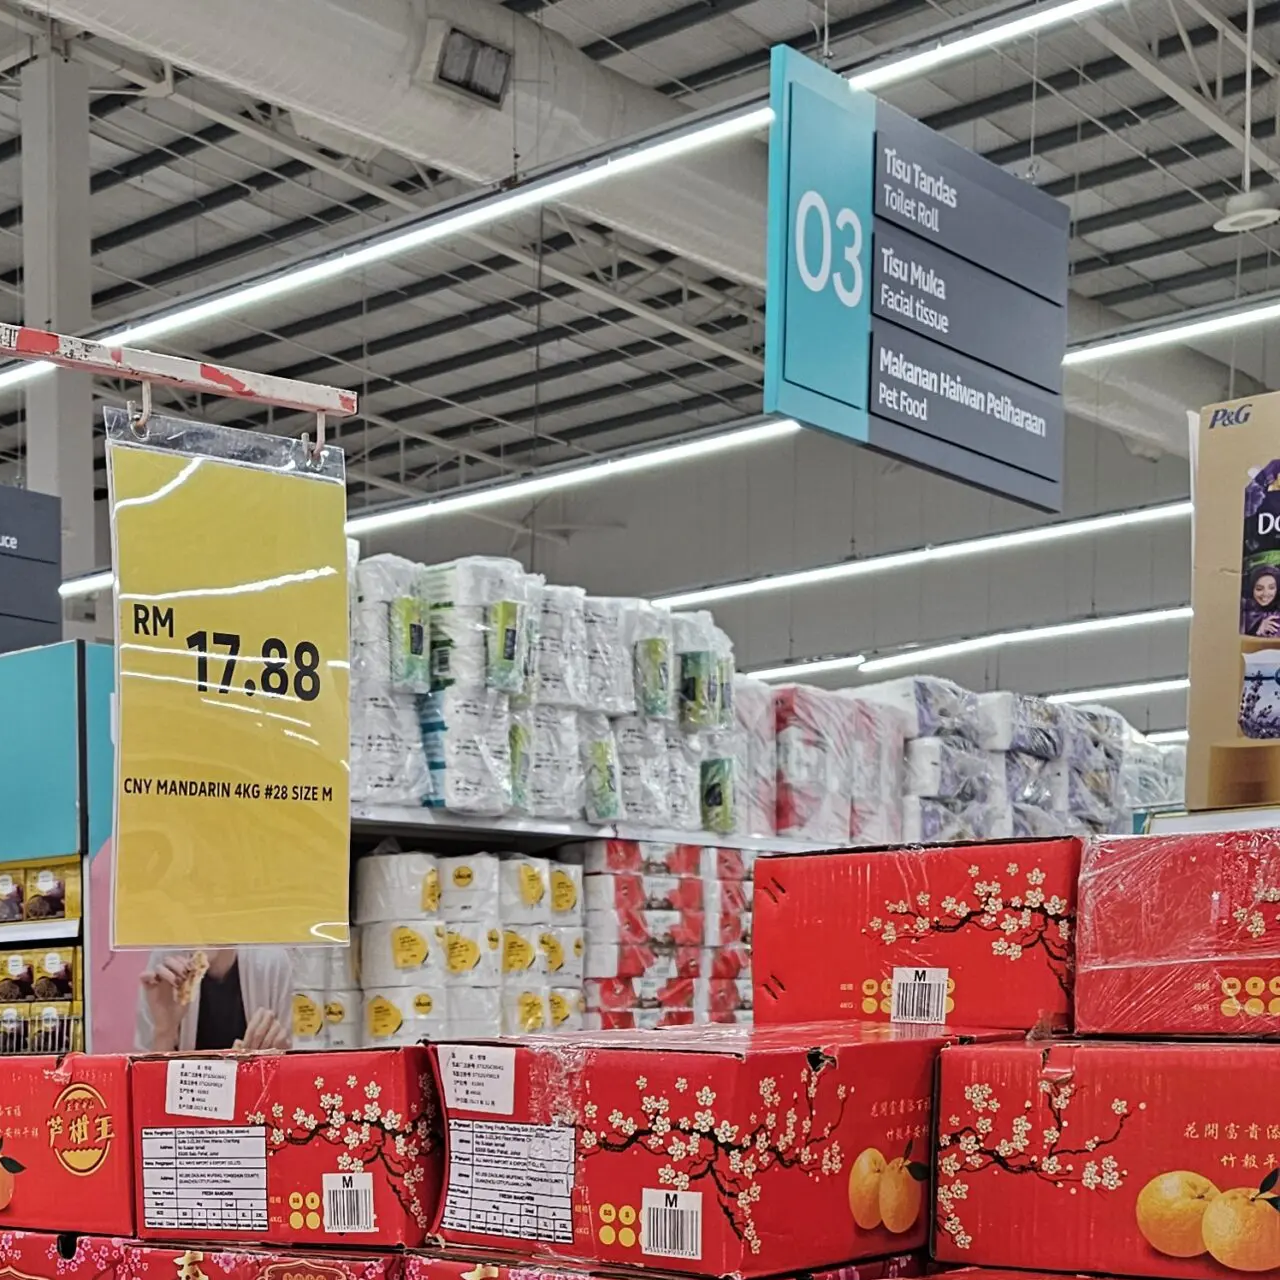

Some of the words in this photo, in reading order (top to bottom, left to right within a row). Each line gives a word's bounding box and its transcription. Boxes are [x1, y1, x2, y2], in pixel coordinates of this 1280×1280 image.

[885, 148, 912, 184] Tisu
[913, 168, 957, 207] Tandas
[884, 184, 916, 221] Toilet
[917, 202, 939, 232] Roll
[795, 190, 863, 307] 03
[882, 247, 909, 285] Tisu
[911, 264, 946, 300] Muka
[881, 283, 914, 319] Facial
[916, 298, 949, 333] tissue
[879, 386, 898, 413] Pet
[900, 394, 927, 421] Food
[880, 348, 937, 391] Makanan
[940, 371, 985, 411] Haiwan
[987, 390, 1046, 436] Peliharaan
[1209, 403, 1253, 430] P&G
[133, 604, 174, 638] RM
[186, 630, 321, 702] 17.88
[124, 778, 152, 796] CNY
[156, 779, 231, 799] MANDARIN
[234, 781, 261, 800] 4KG
[264, 783, 288, 801] #28
[292, 784, 318, 802] SIZE
[322, 785, 333, 802] M
[914, 970, 926, 983] M
[47, 1113, 115, 1149] 芦柑王
[342, 1176, 353, 1189] M
[665, 1194, 678, 1208] M
